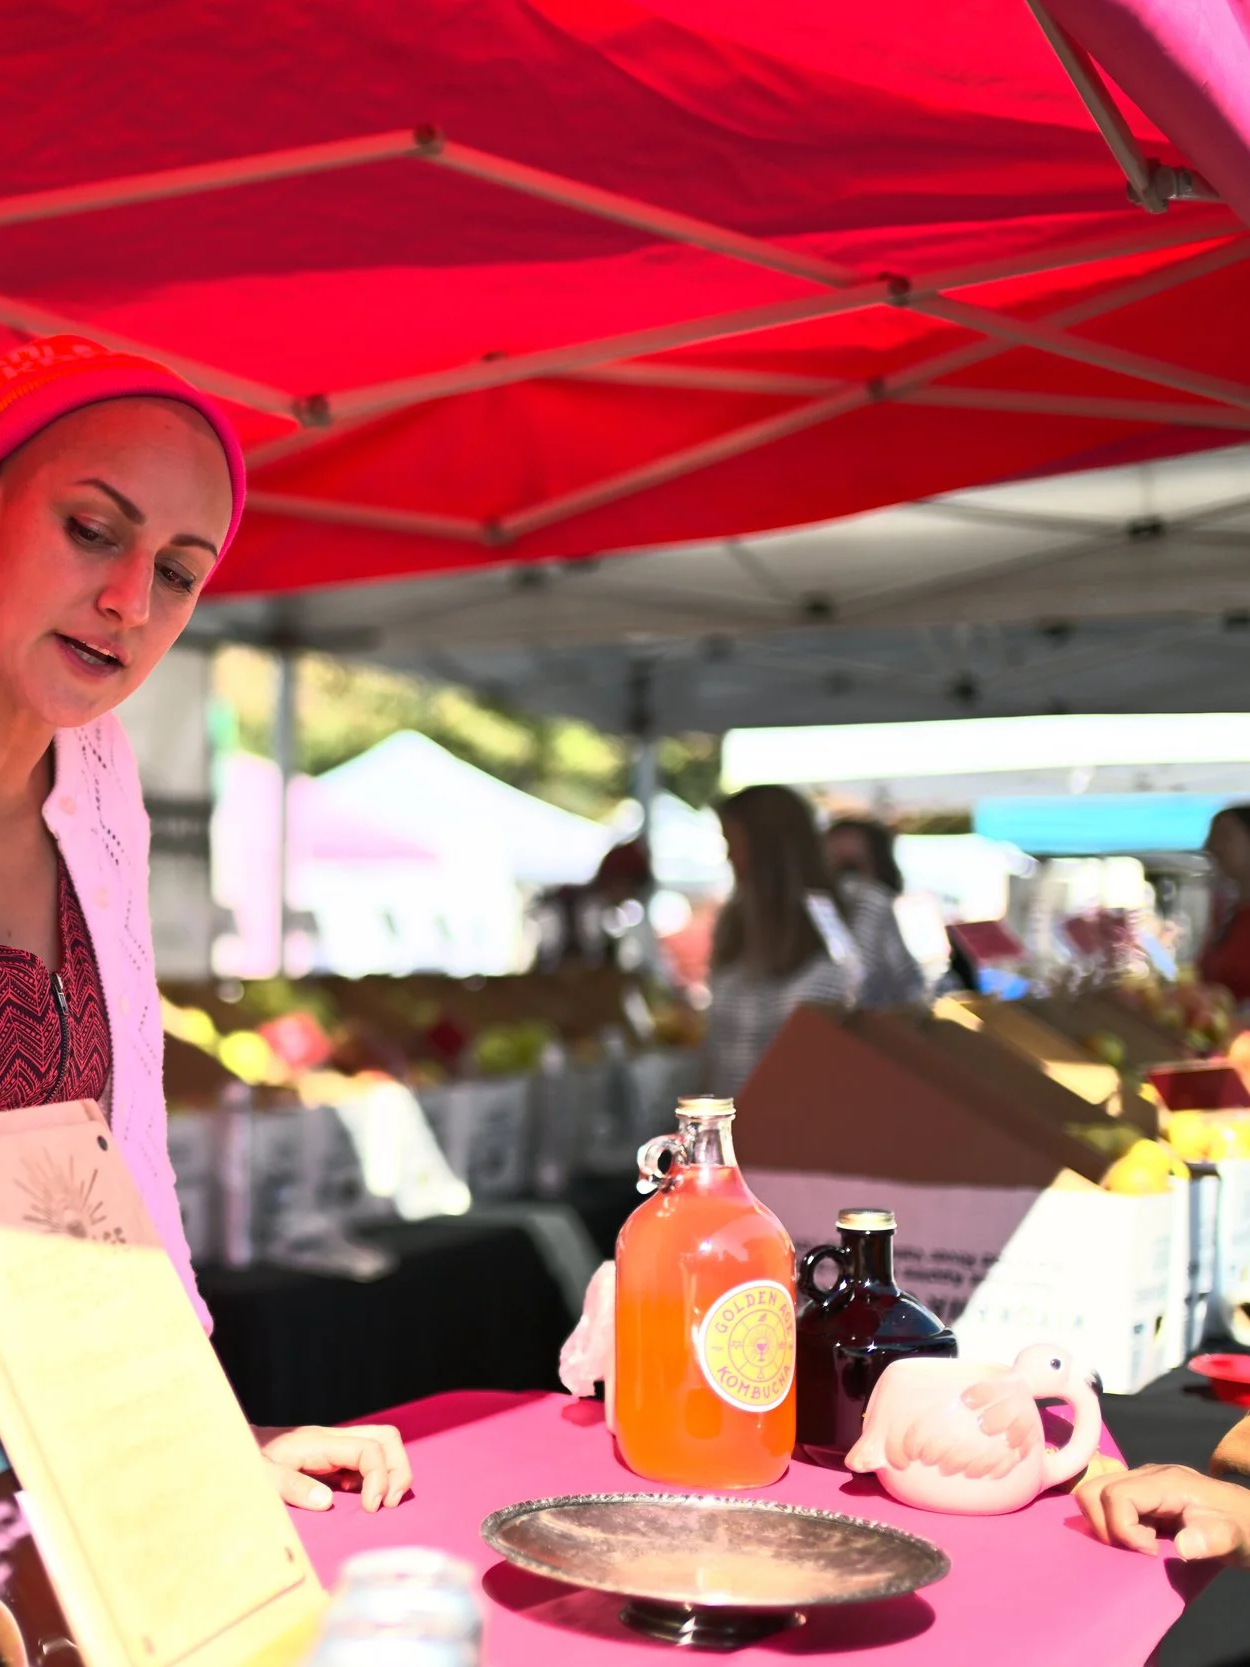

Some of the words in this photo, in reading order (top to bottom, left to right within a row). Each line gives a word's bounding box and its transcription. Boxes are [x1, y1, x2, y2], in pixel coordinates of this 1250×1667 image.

[715, 1291, 777, 1334] GOLDEN
[780, 1303, 793, 1336] AGE
[717, 1365, 790, 1399] KOMBUCHA
